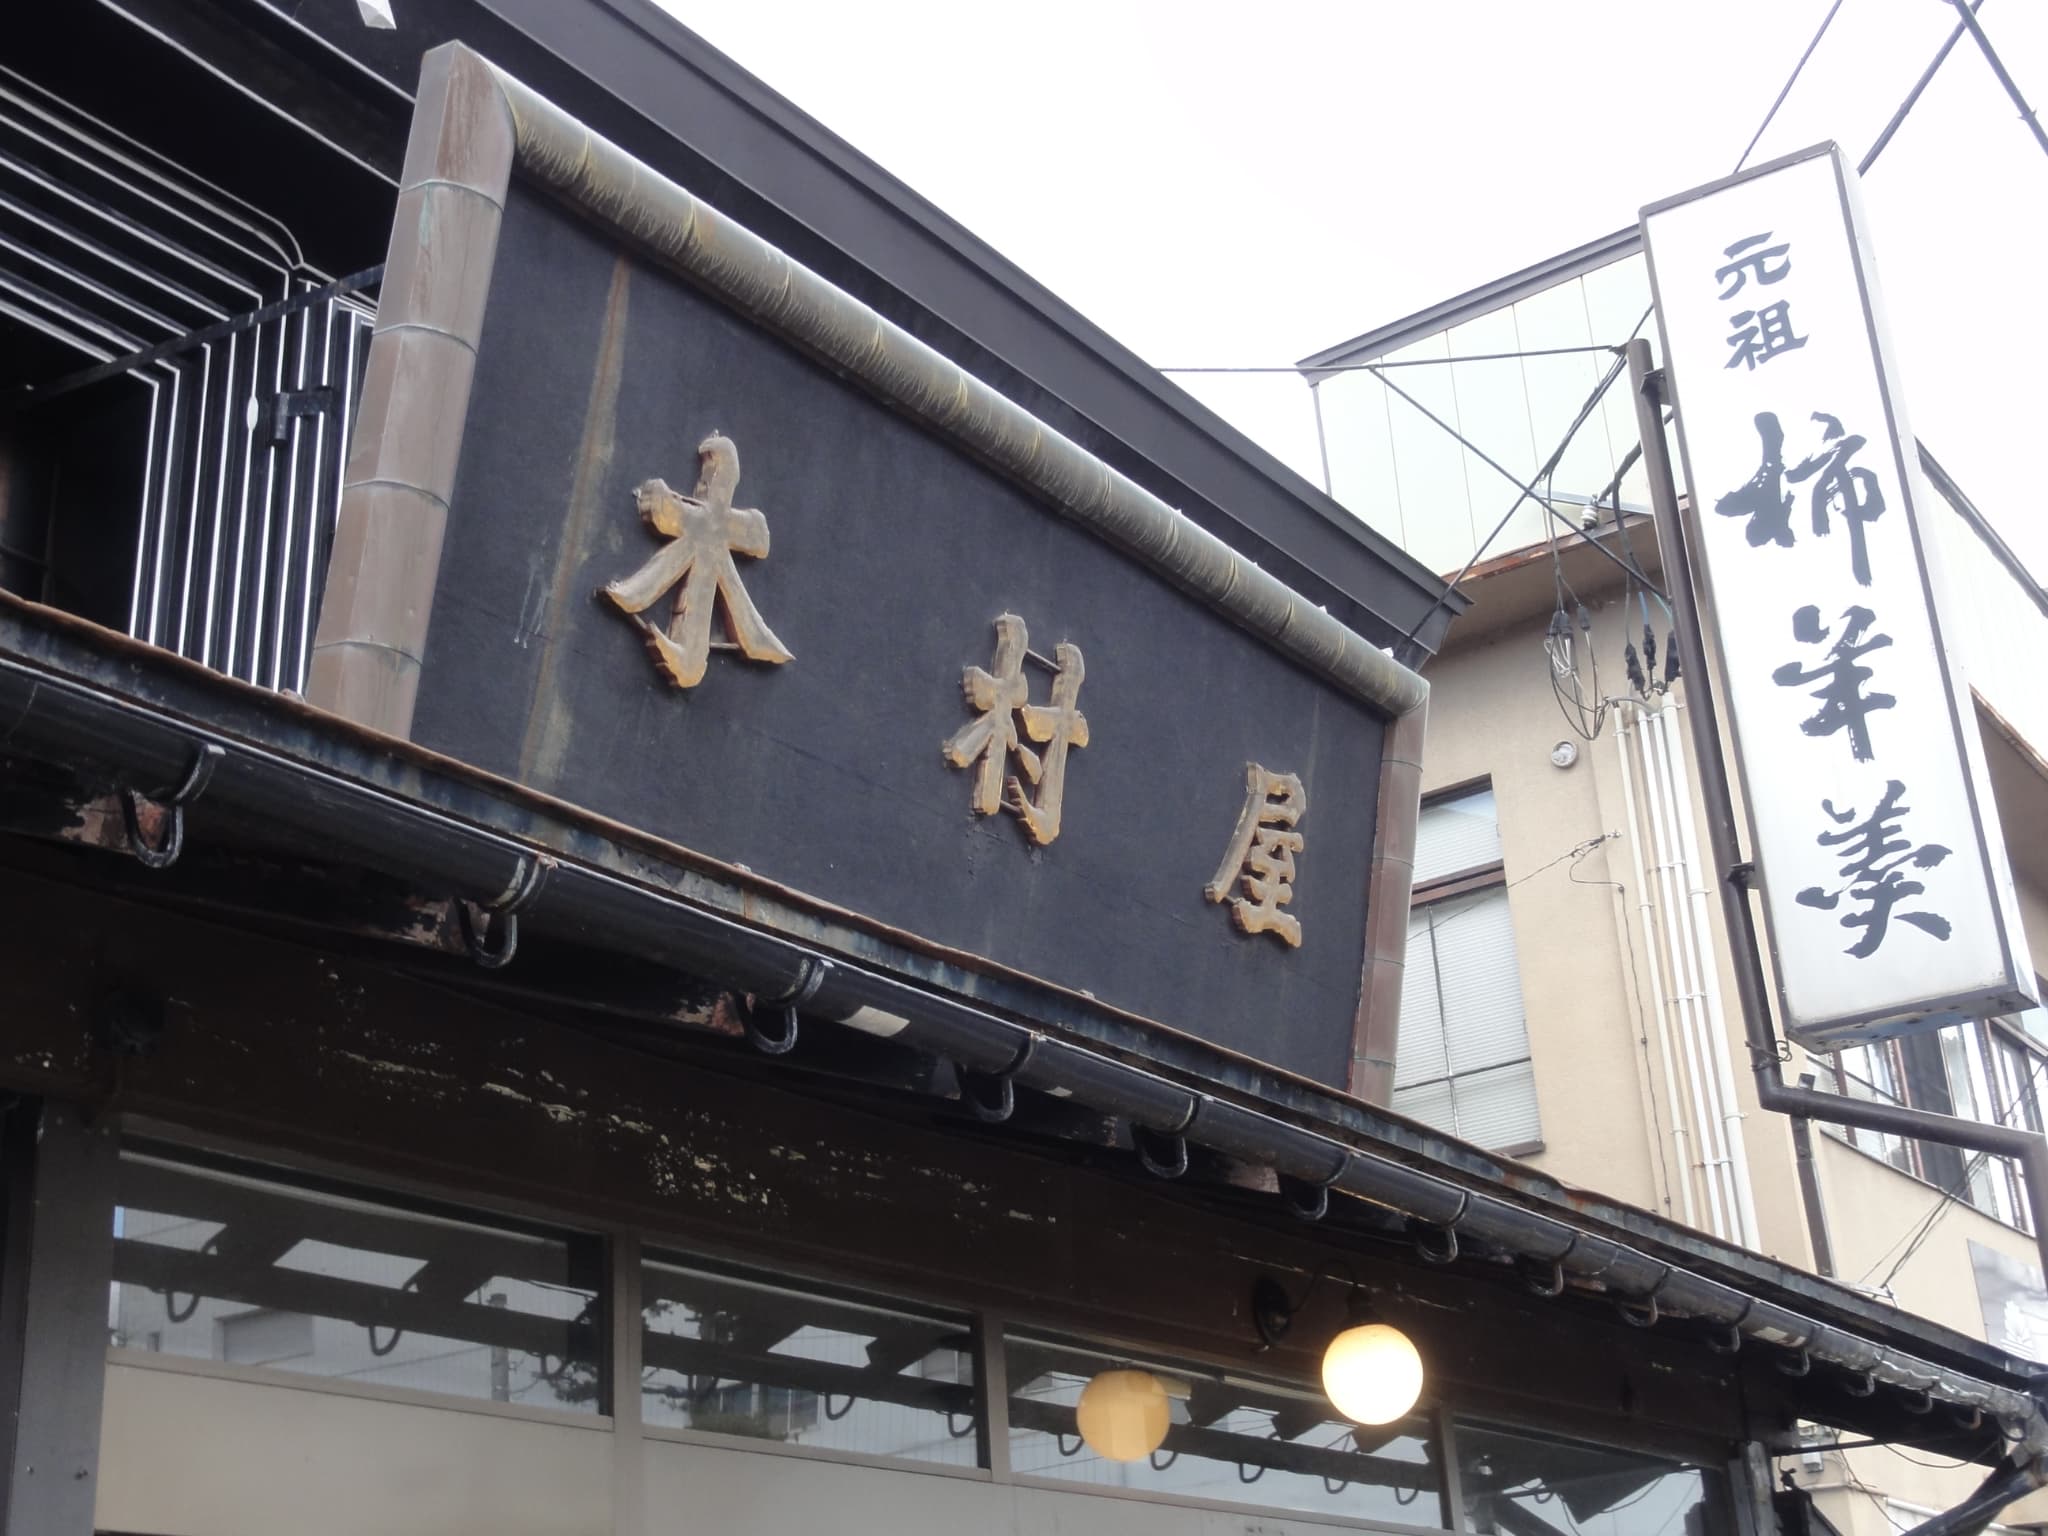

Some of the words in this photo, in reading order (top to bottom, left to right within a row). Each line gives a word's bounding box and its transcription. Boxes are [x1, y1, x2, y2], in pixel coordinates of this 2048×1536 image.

[1715, 232, 1808, 370] 元祖
[605, 431, 1306, 947] 木村屋
